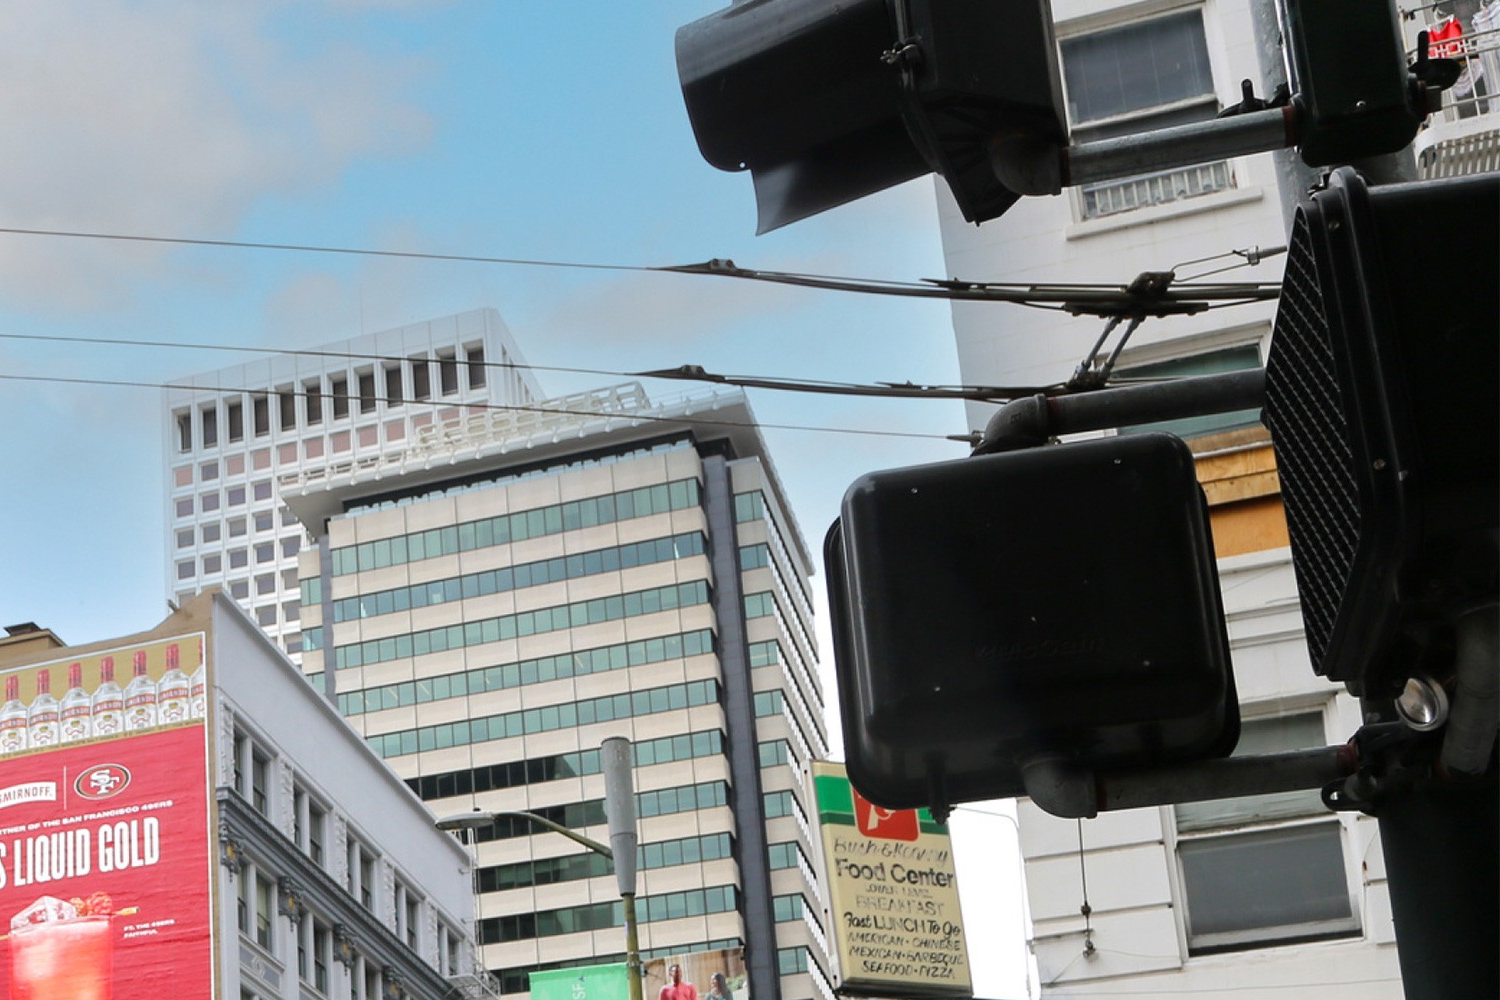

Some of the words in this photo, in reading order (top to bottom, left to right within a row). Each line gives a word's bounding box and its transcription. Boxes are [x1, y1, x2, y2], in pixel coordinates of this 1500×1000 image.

[27, 822, 41, 831] OF
[42, 819, 61, 828] THE
[62, 816, 82, 825] SAN
[84, 805, 140, 821] FRANCISCO
[13, 828, 91, 887] LIQUID
[98, 817, 160, 873] GOLD
[835, 857, 886, 882] Food
[890, 862, 954, 888] Center
[873, 914, 926, 933] LUNCH
